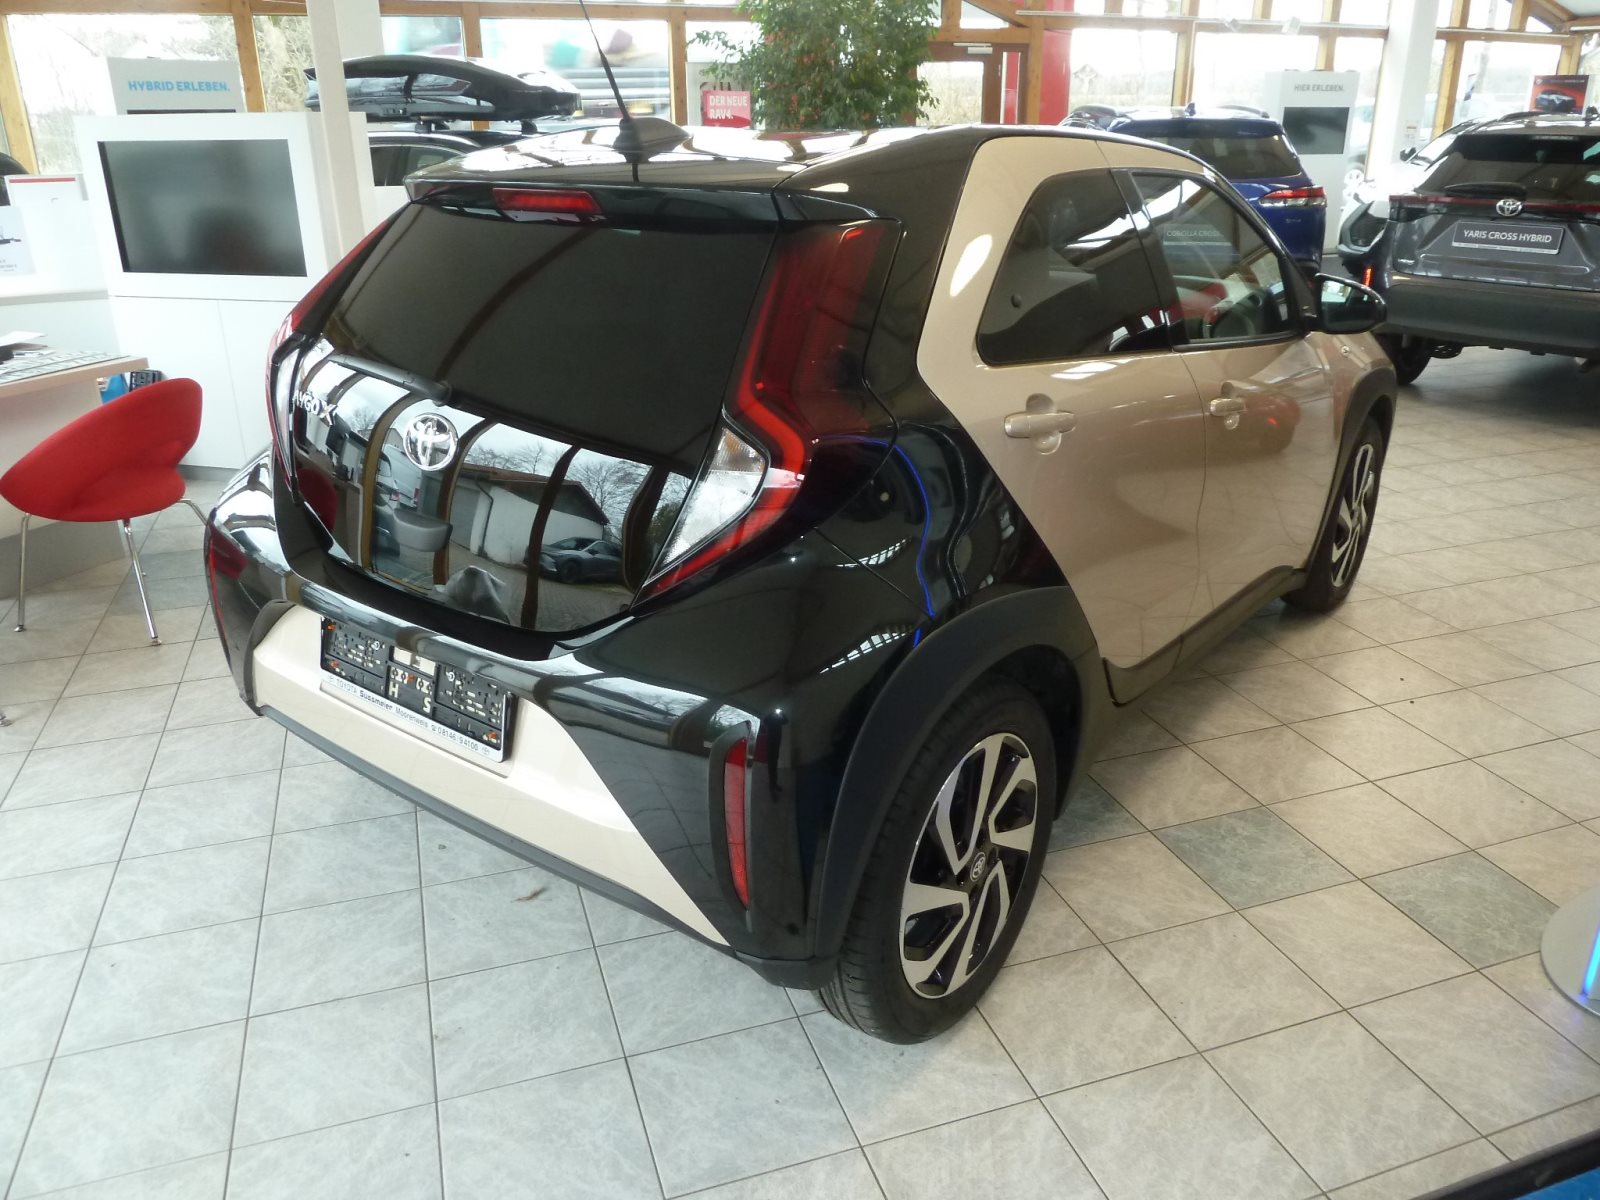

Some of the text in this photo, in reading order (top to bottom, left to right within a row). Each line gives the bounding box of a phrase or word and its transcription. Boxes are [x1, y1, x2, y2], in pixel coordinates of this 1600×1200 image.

[127, 80, 230, 92] HYBRID ERLEBEN.
[709, 95, 748, 107] DER NEUE
[1463, 229, 1553, 243] YARIS CROSS HYBRID
